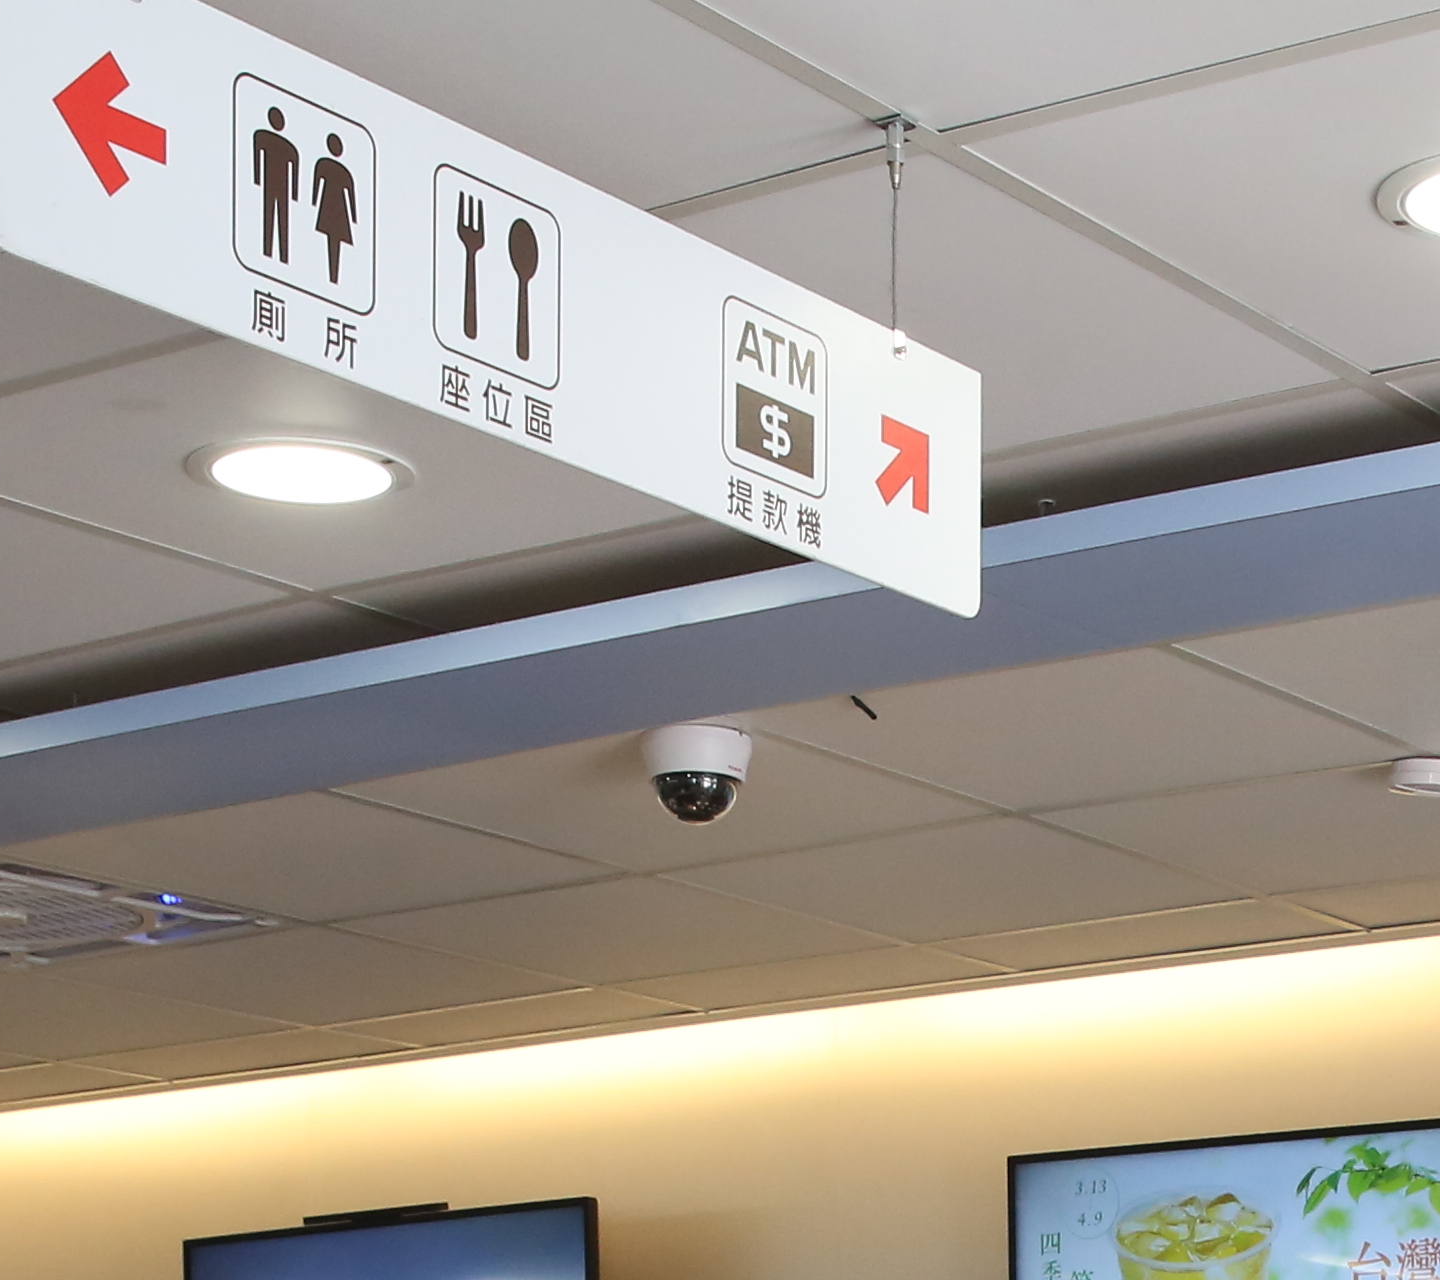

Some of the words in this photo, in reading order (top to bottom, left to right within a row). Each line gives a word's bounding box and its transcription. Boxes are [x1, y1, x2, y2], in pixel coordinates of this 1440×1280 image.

[252, 289, 359, 370] 廁所
[736, 320, 817, 396] ATM
[439, 365, 554, 446] 座位區
[727, 477, 824, 550] 提款機
[1074, 1179, 1107, 1197] 3.13
[1078, 1211, 1103, 1227] 4.9
